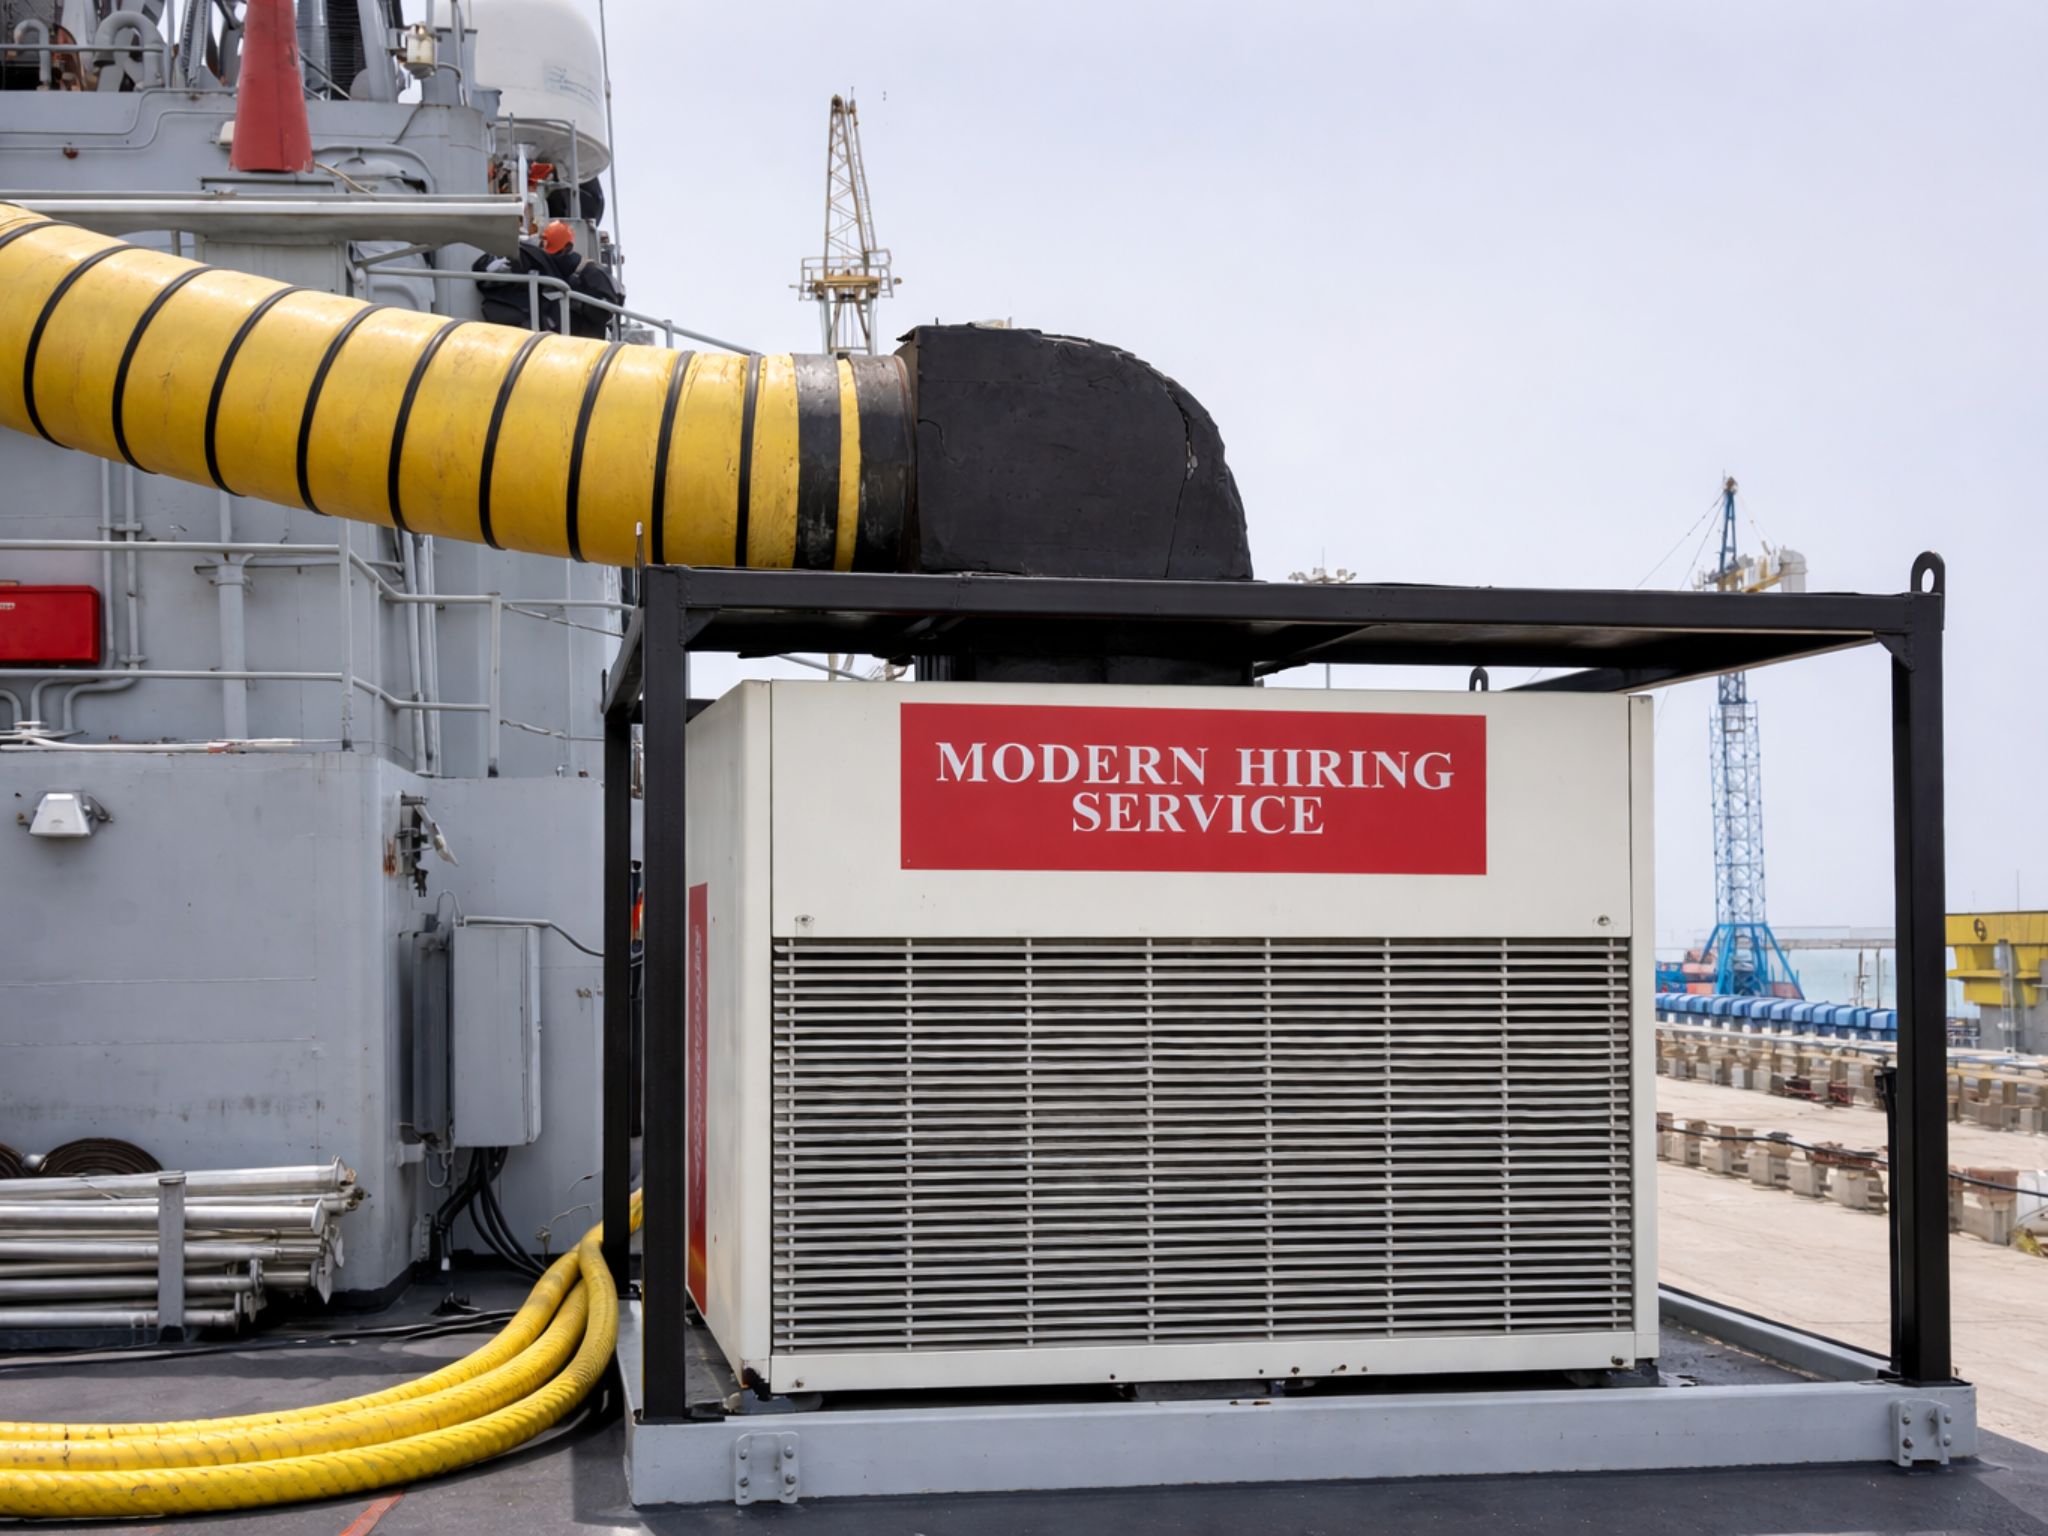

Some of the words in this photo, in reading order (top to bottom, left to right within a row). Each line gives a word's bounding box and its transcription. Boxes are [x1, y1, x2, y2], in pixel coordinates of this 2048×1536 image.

[935, 742, 1208, 786] MODERN
[1236, 748, 1454, 790] HIRING
[1072, 791, 1324, 835] SERVICE
